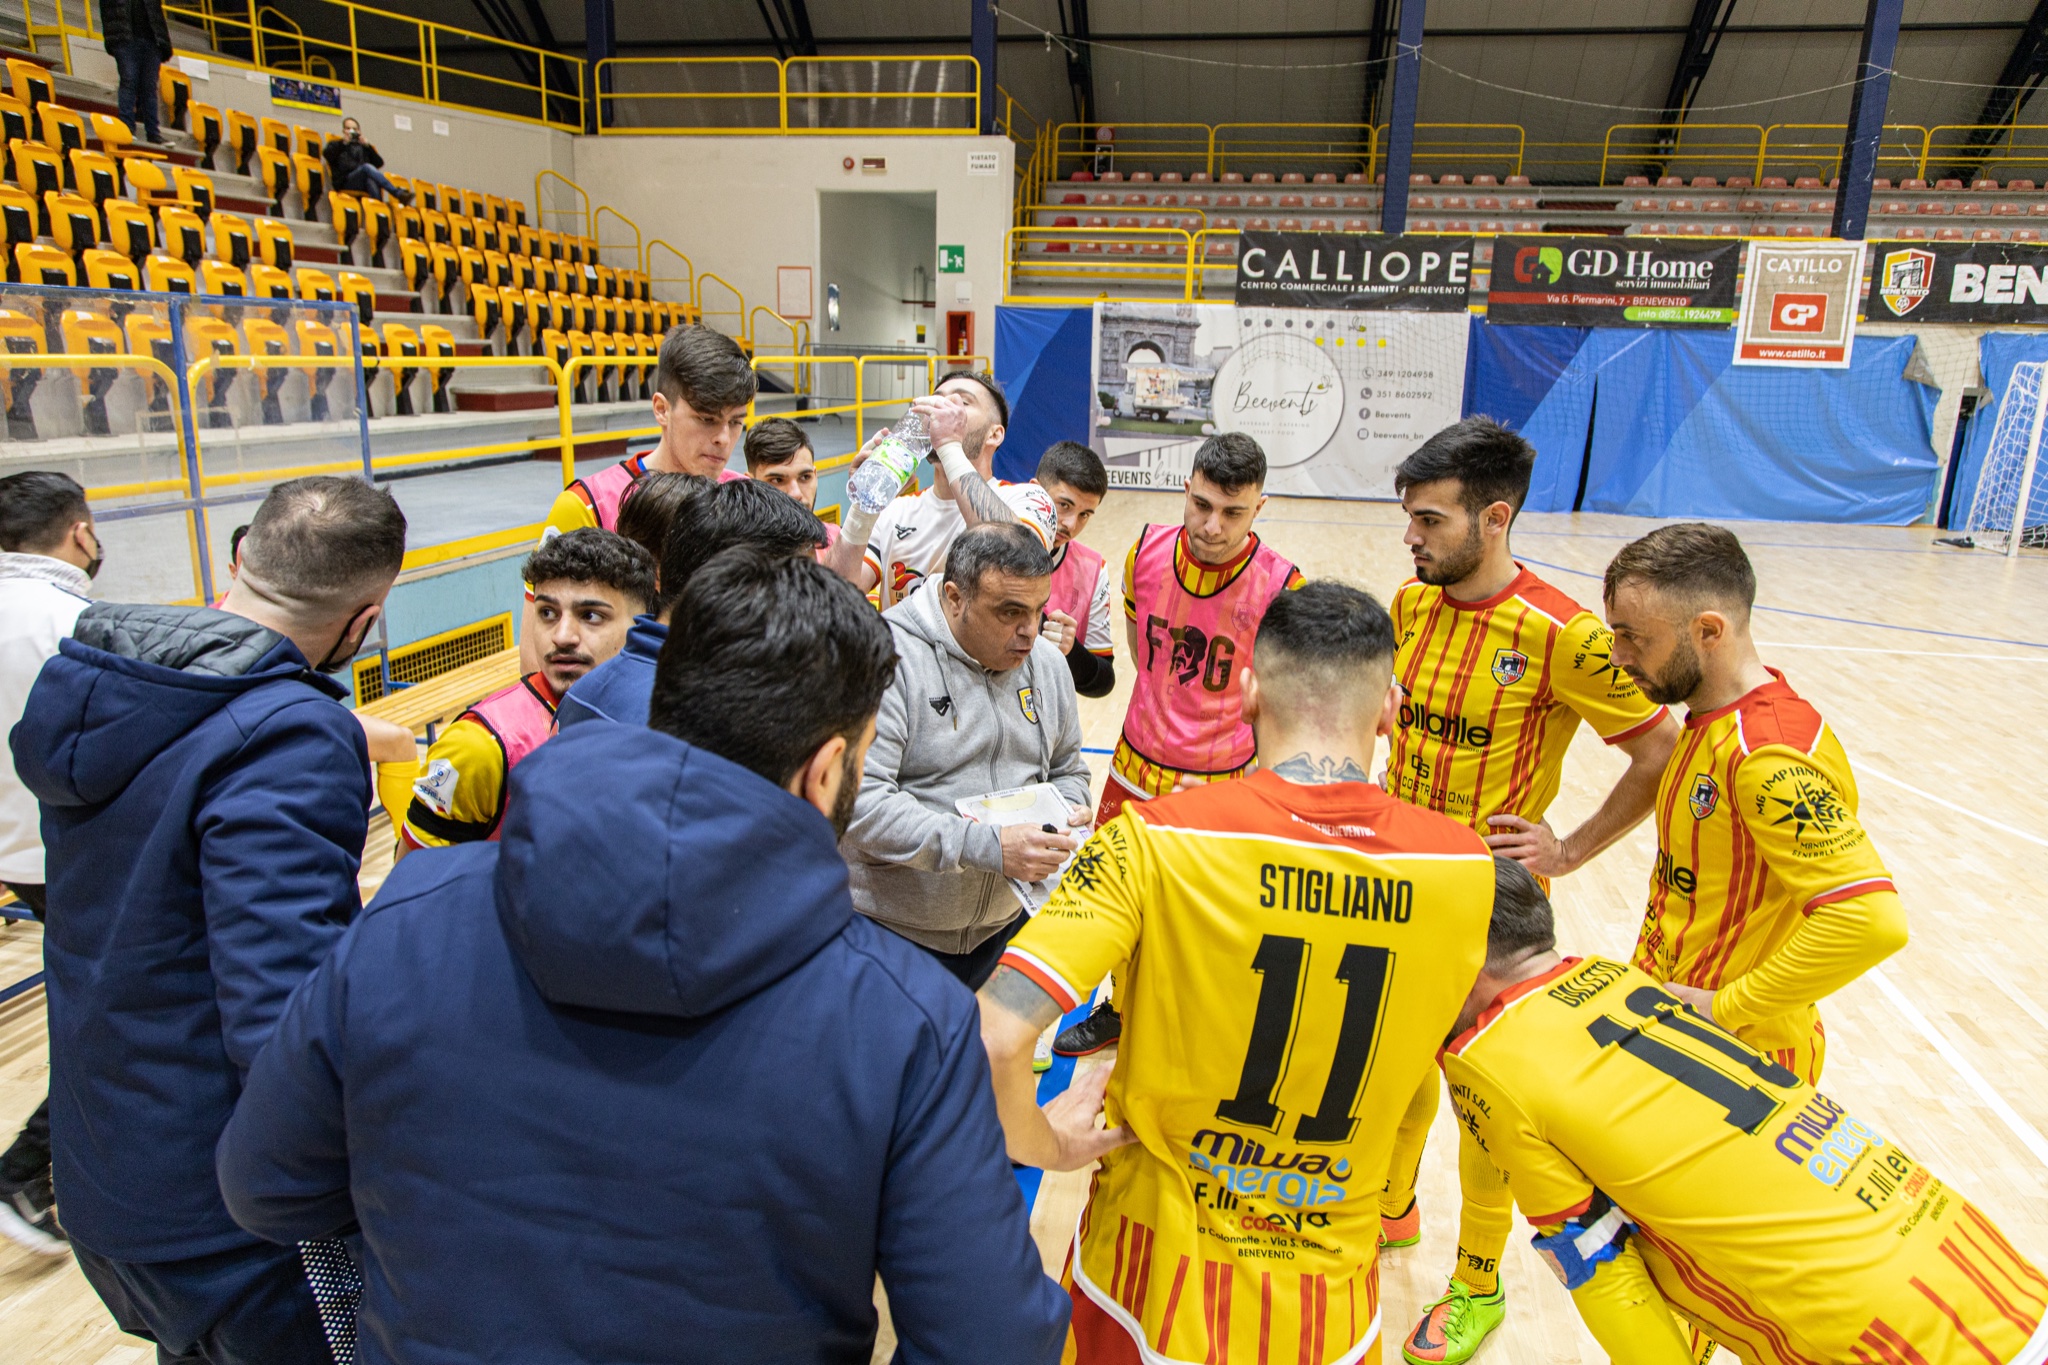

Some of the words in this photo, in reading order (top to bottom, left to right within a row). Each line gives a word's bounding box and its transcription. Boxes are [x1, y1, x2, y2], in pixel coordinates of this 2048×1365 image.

[1242, 248, 1470, 283] CALLIOPE
[1567, 248, 1618, 277] GD
[1624, 250, 1714, 280] Home
[1766, 257, 1843, 274] CATILLO
[1240, 281, 1278, 290] CENTRO
[1280, 282, 1348, 293] COMMERCIALE
[1357, 285, 1400, 294] SANNITI
[1408, 286, 1466, 295] BENEVENTO
[1615, 278, 1648, 289] servizi
[1650, 277, 1711, 290] immobiliari
[1787, 274, 1819, 285] S.R.L.
[1880, 287, 1930, 296] BENEVENTO
[1547, 294, 1560, 304] Via
[1561, 294, 1571, 304] G.
[1572, 294, 1618, 307] Piermarini,
[1632, 296, 1687, 307] BENEVENTO
[1638, 310, 1656, 319] info
[1758, 348, 1827, 360] www.catillo.it
[1377, 370, 1394, 378] 349
[1397, 370, 1434, 379] 1204958
[1232, 381, 1328, 418] Beevents
[1376, 390, 1392, 398] 351
[1395, 391, 1433, 400] 8602592
[1375, 410, 1411, 419] Beevents
[1373, 430, 1424, 442] beevents_bn
[1573, 652, 1587, 670] MG
[1401, 775, 1471, 806] COSTRUZIONI
[1756, 794, 1766, 816] MG
[1260, 863, 1413, 924] STIGLIANO
[1547, 960, 1629, 1008] GALLETTO
[1214, 934, 1396, 1145] 11
[1774, 1093, 1846, 1166] miwa
[1191, 1128, 1331, 1175] miwa
[1208, 1227, 1260, 1246] Colonnette
[1270, 1236, 1288, 1248] Via
[1290, 1238, 1299, 1248] S.
[1237, 1248, 1296, 1261] BENEVENTO
